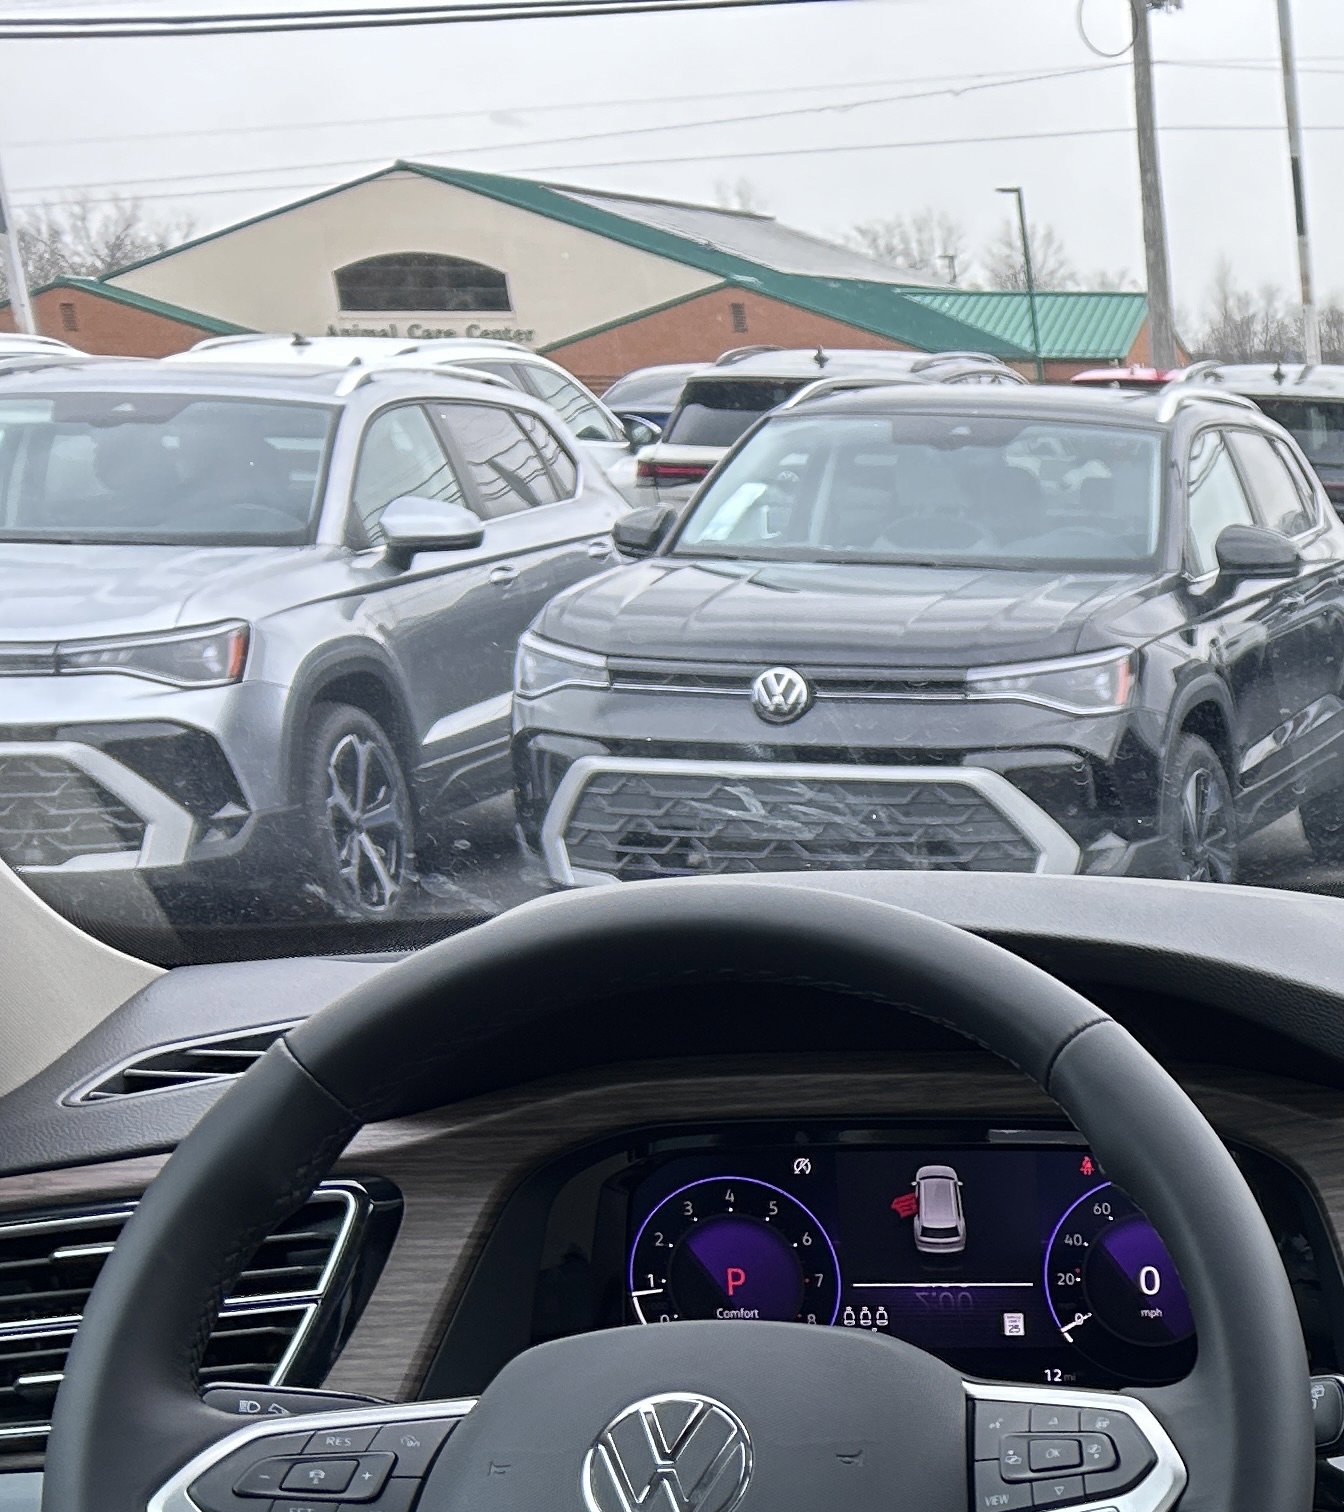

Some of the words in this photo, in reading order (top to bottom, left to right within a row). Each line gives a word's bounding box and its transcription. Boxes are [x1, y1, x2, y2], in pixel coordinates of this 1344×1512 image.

[407, 324, 456, 338] Care
[465, 324, 535, 341] Center
[725, 1188, 735, 1203] 4
[683, 1201, 694, 1216] 3
[768, 1201, 778, 1216] 5
[1093, 1202, 1112, 1215] 60
[655, 1232, 665, 1247] 2
[802, 1231, 812, 1246] 6
[1064, 1233, 1083, 1247] 40
[647, 1273, 655, 1288] 1
[726, 1267, 746, 1296] P
[814, 1273, 824, 1287] 7
[1056, 1273, 1075, 1286] 20
[1139, 1266, 1161, 1295] 0
[715, 1307, 760, 1319] Comfort
[807, 1314, 817, 1325] 8
[1140, 1307, 1163, 1319] mph
[1043, 1368, 1062, 1382] 12
[325, 1436, 352, 1447] RES
[984, 1494, 1010, 1507] VIEW
